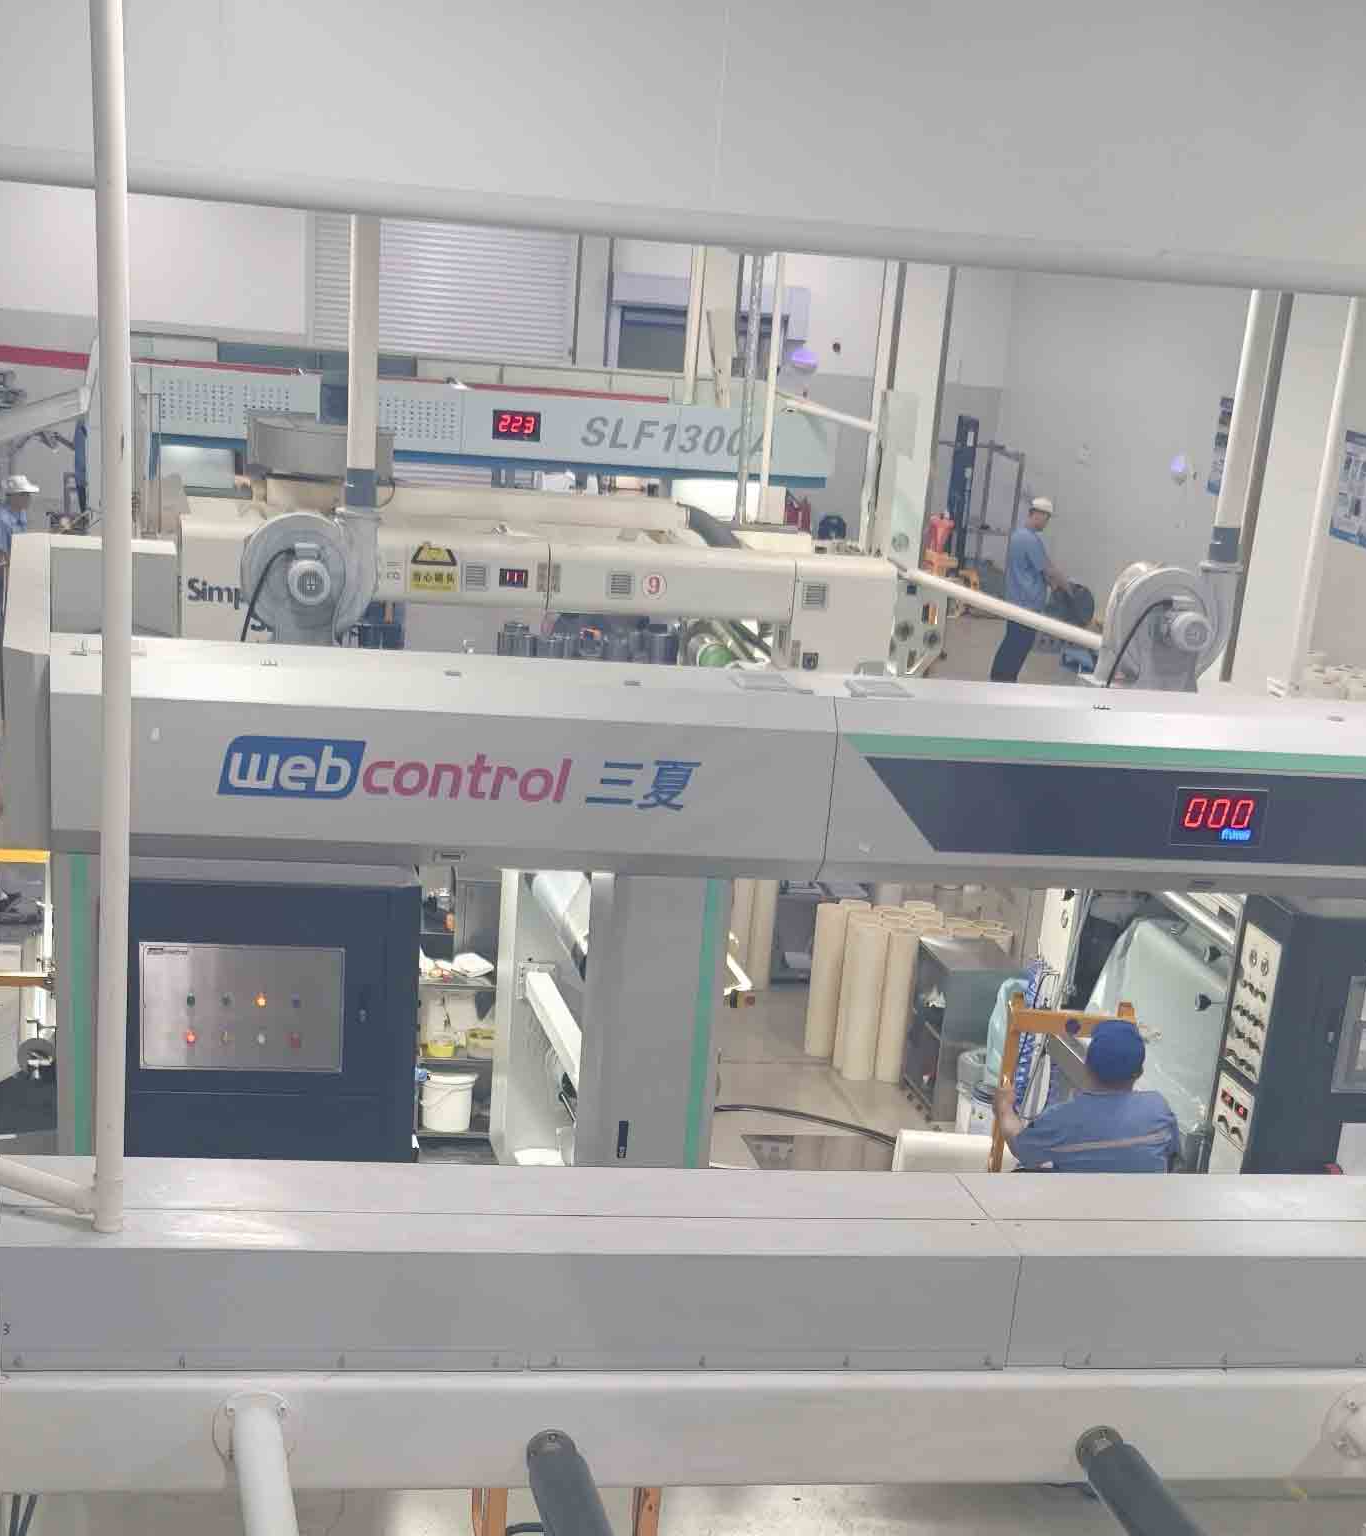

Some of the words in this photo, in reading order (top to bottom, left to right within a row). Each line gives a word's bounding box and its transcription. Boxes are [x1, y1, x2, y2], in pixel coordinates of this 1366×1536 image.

[498, 415, 535, 433] 223
[584, 759, 702, 811] 三夏
[1184, 798, 1254, 828] 000
